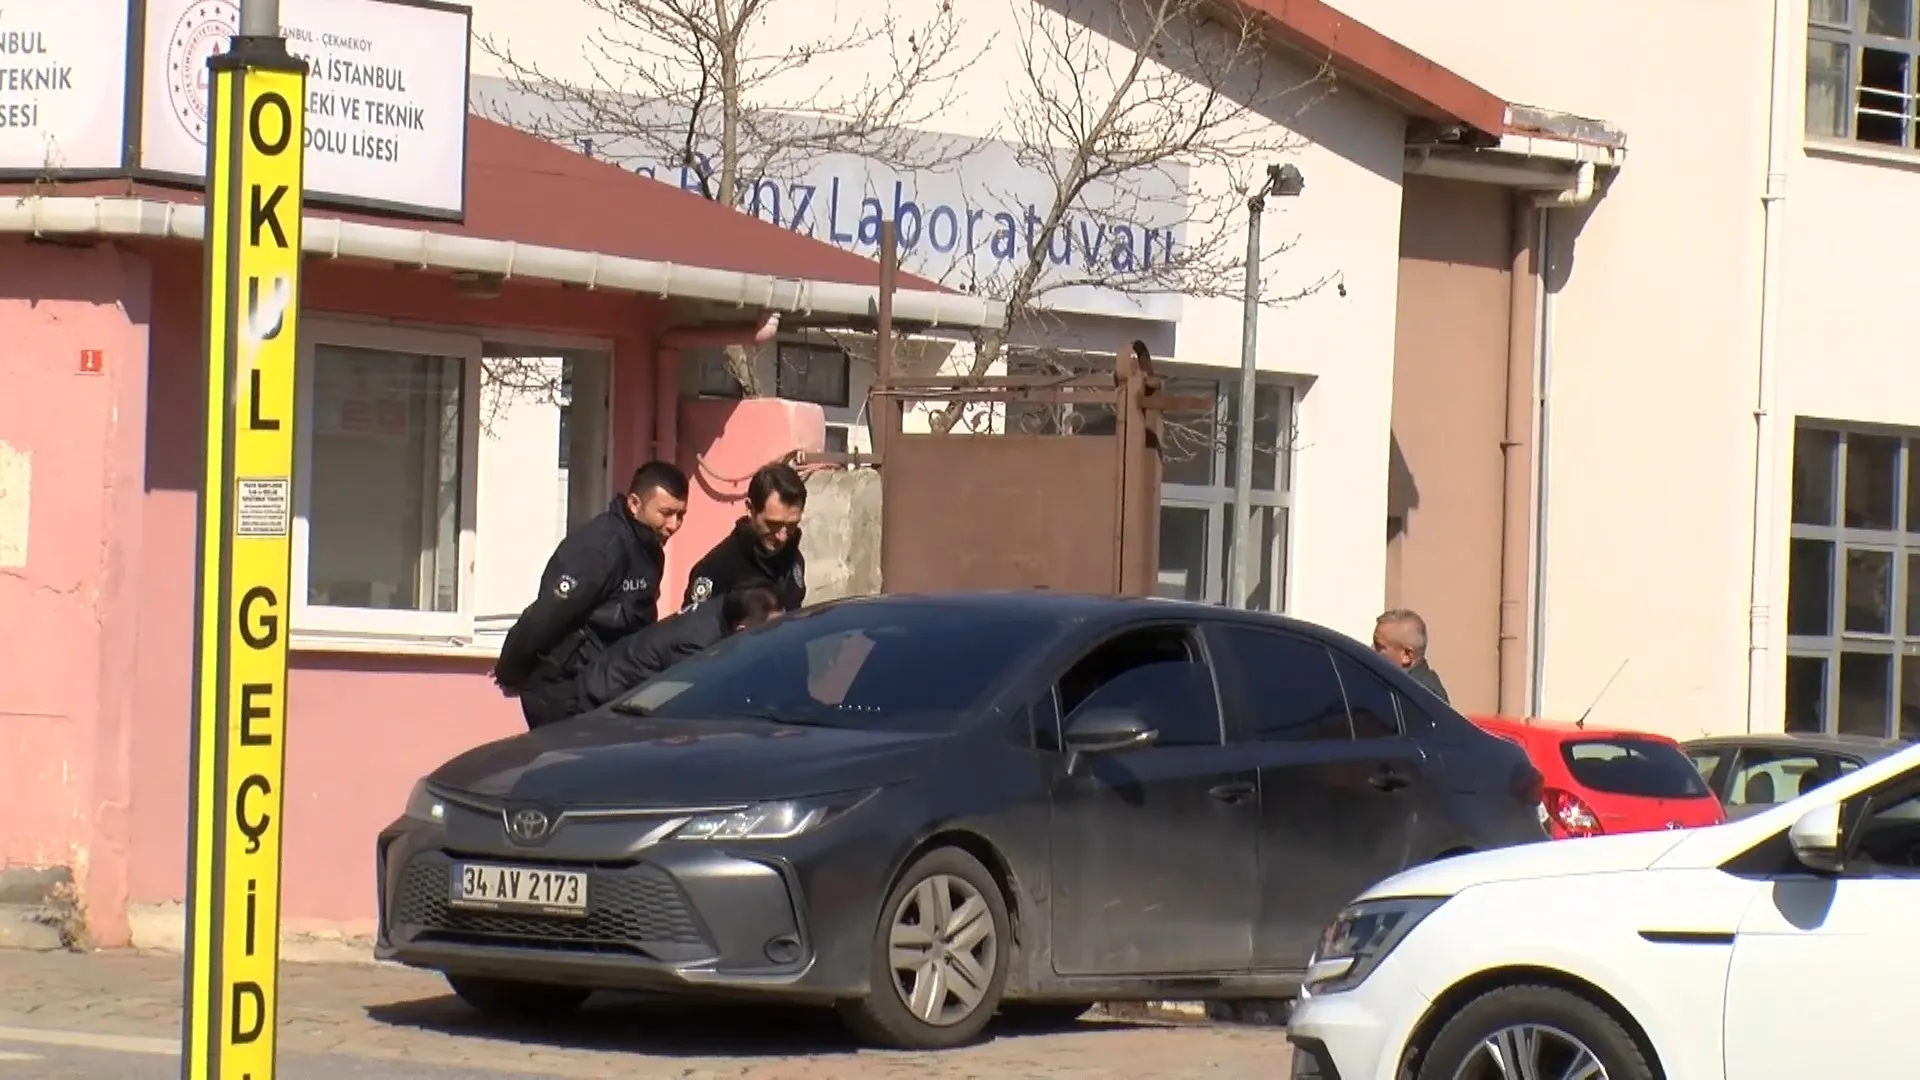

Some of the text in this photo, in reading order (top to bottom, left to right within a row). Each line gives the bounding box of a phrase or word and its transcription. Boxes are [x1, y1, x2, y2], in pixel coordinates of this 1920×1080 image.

[328, 53, 406, 92] İSTANBUL
[304, 90, 425, 131] EKİ VE TEKNİK
[353, 130, 399, 163] LİSESİ
[248, 92, 293, 431] OKUL
[231, 585, 278, 1080] GEÇİD
[464, 867, 579, 903] 34 AV 2173
